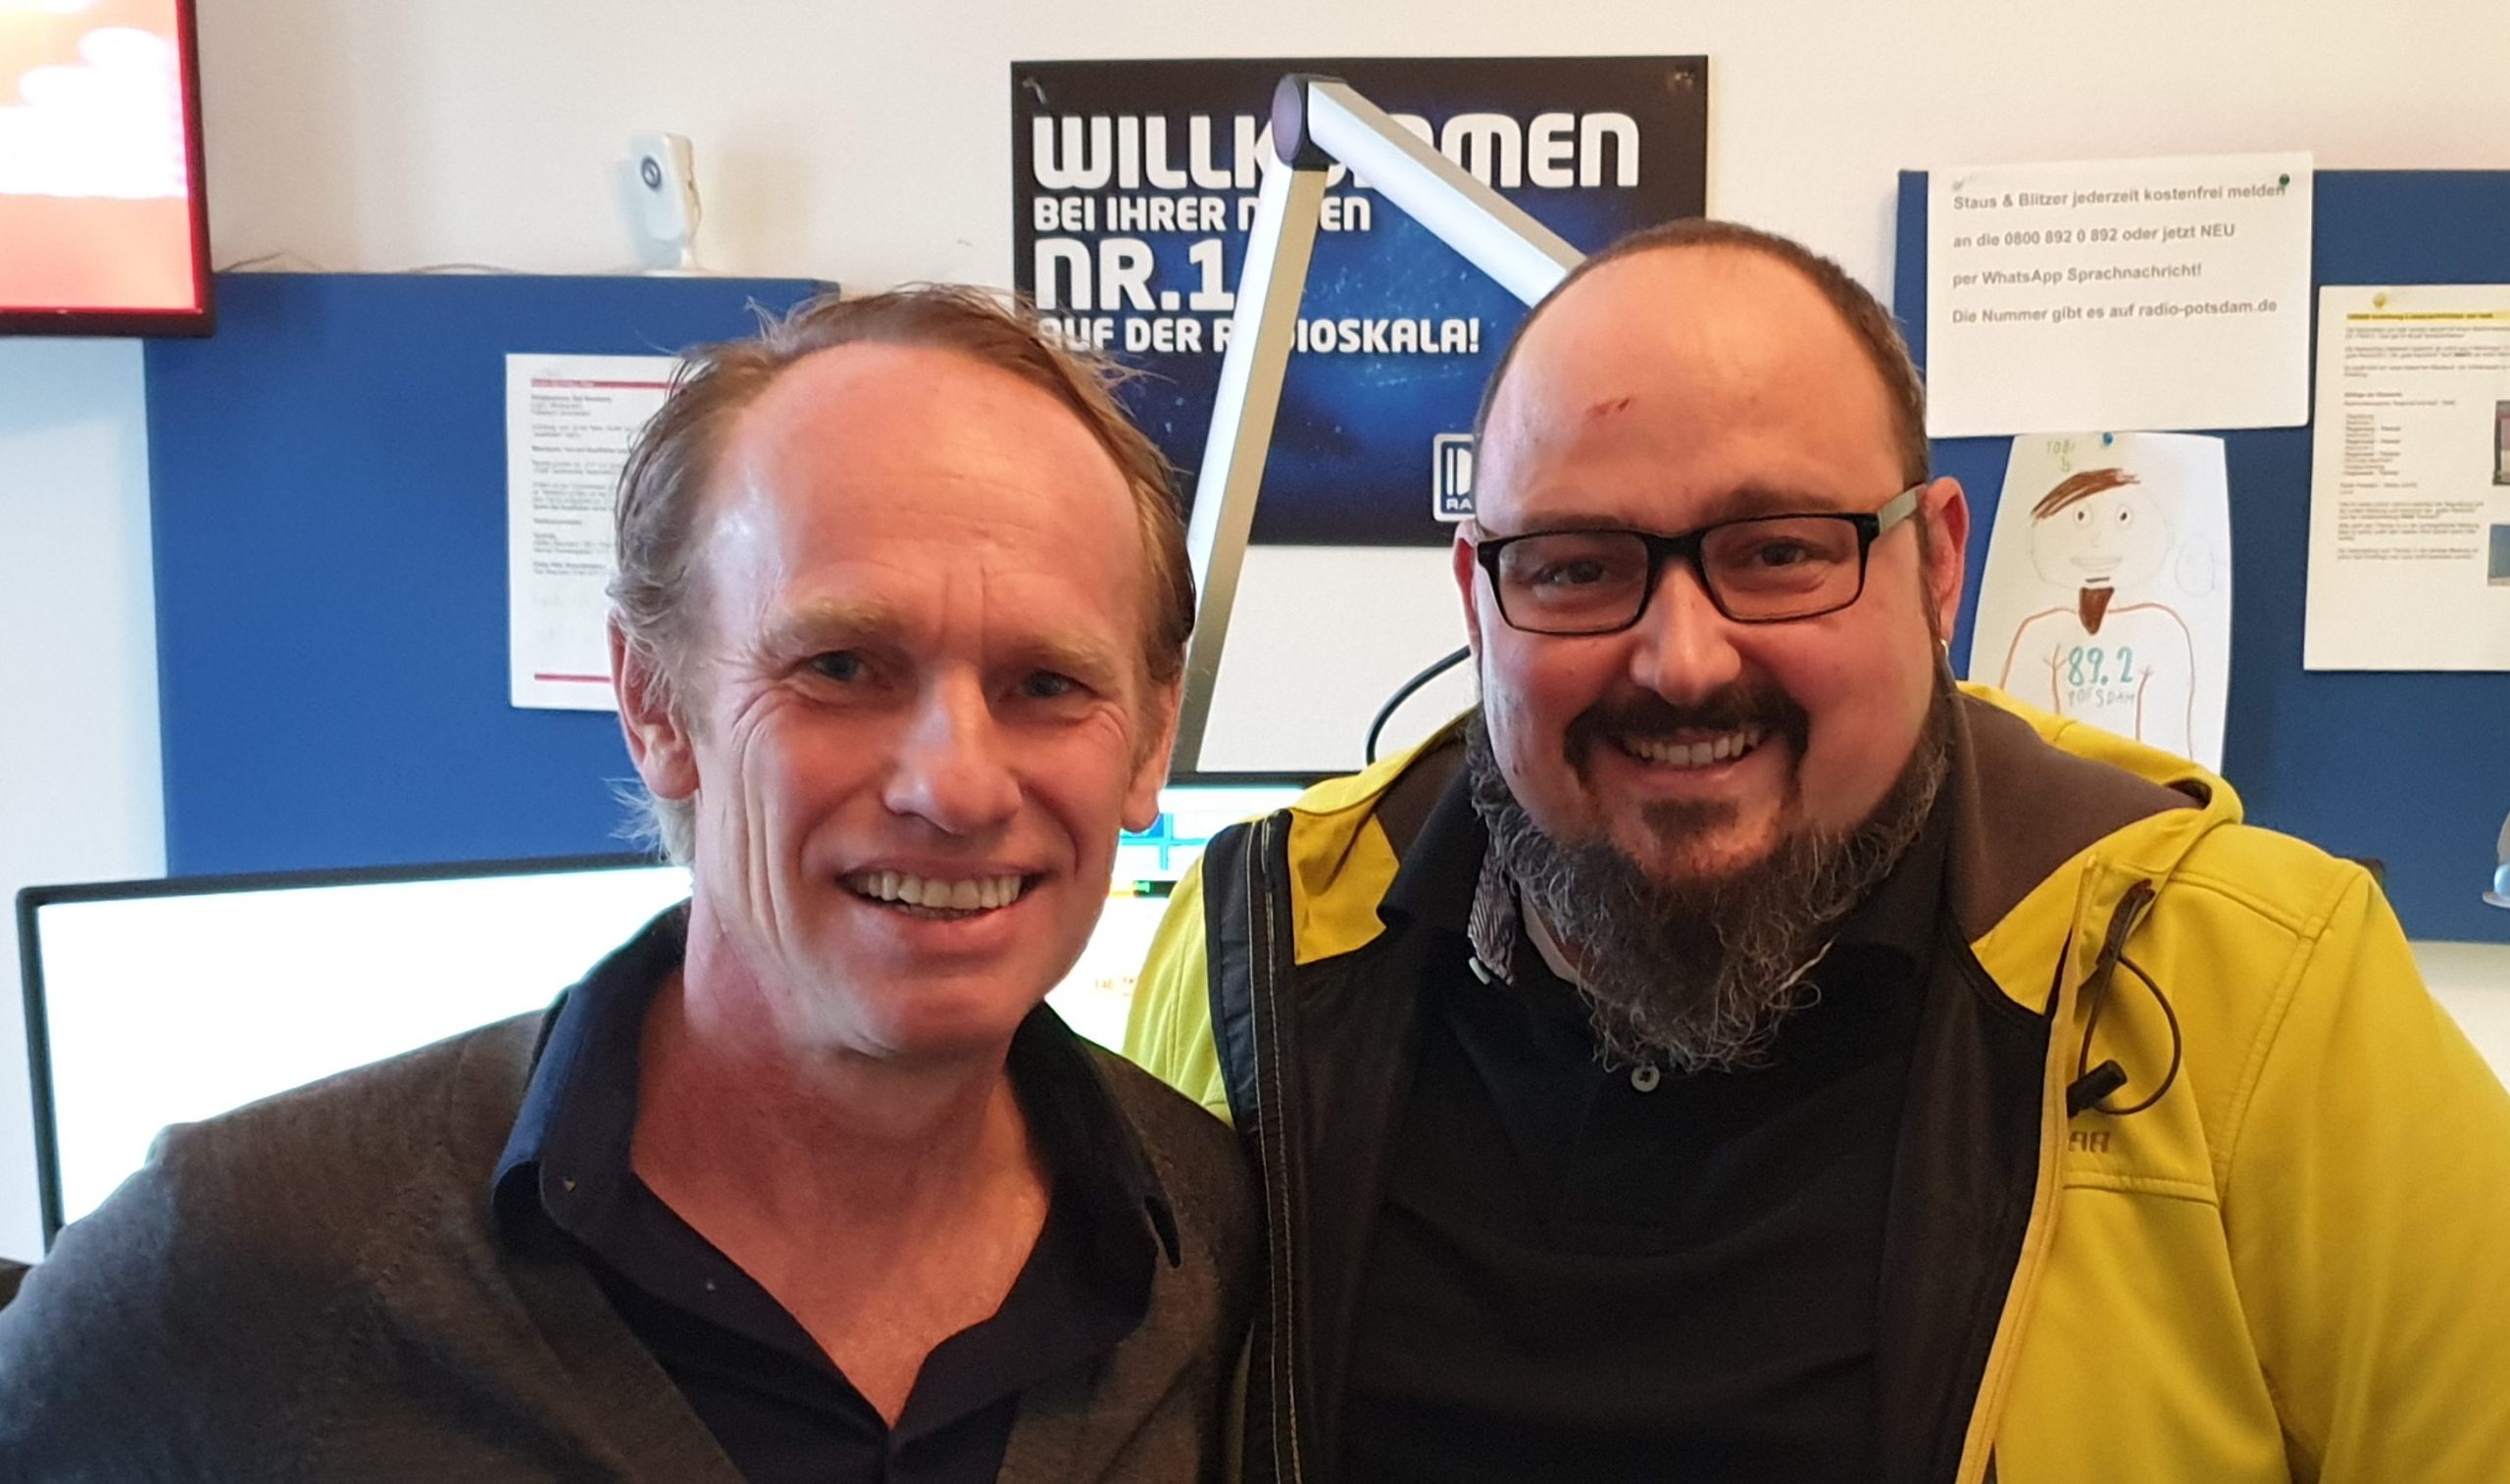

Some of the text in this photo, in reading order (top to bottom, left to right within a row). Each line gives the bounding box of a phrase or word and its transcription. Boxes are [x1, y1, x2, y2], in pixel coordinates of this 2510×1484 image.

[1033, 113, 1638, 189] WILLKMEN
[1034, 196, 1371, 231] BEI IHRER NEN
[1953, 183, 2286, 210] Staus & Blitzer jederzeit kostenfrei melden
[1953, 223, 2235, 248] an die 0800 892 0 892 oder jetzt NEU
[1034, 237, 1235, 312] NR.1
[1953, 263, 2202, 289] per WhatsApp Sprachnachricht!
[1952, 298, 2278, 323] Die Nummer gibt es auf radio-potsdam.de
[1039, 317, 1480, 353] AUF DER RIOSKALA!
[2068, 645, 2134, 687] 89.2
